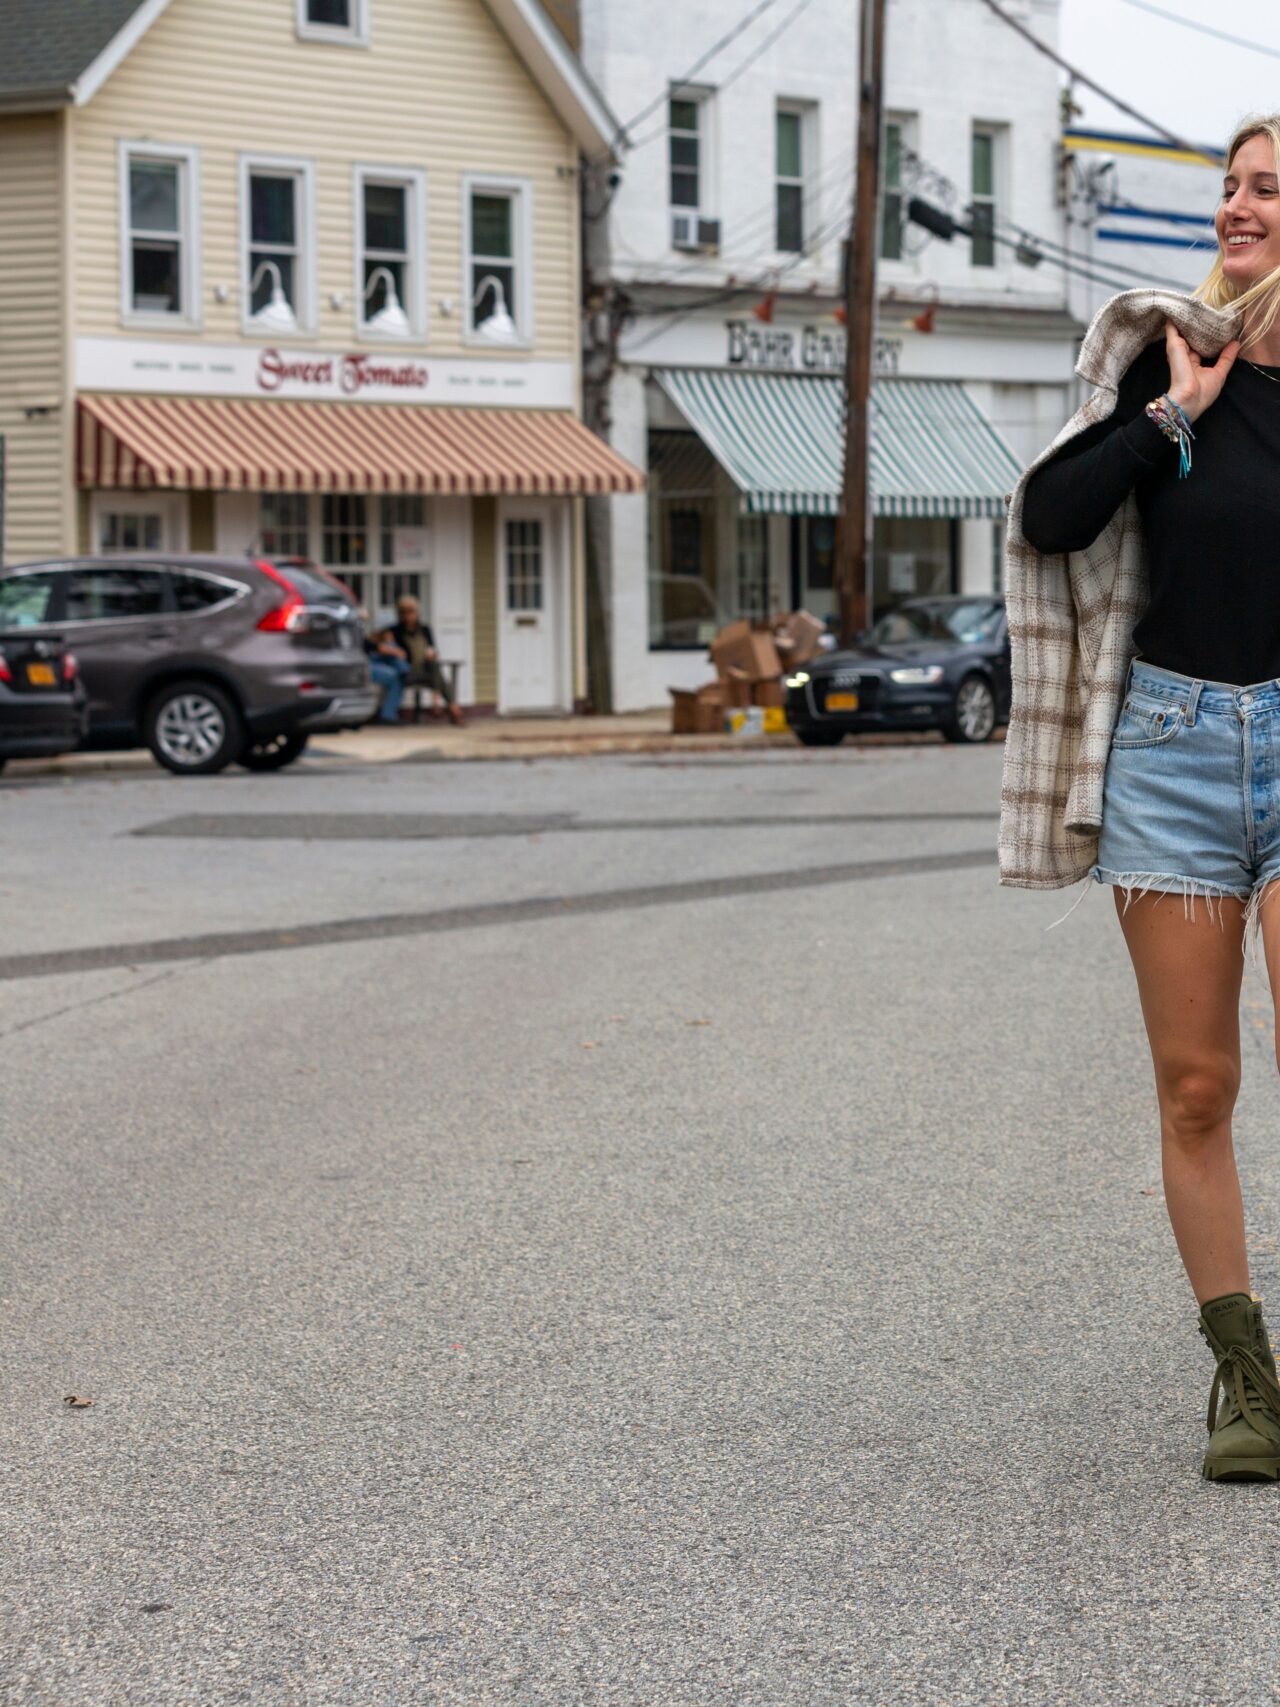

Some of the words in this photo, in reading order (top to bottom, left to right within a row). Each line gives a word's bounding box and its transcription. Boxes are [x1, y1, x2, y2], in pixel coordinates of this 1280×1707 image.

[256, 348, 332, 391] Sweet
[339, 353, 428, 394] Tomato
[1210, 1300, 1240, 1314] PRADA
